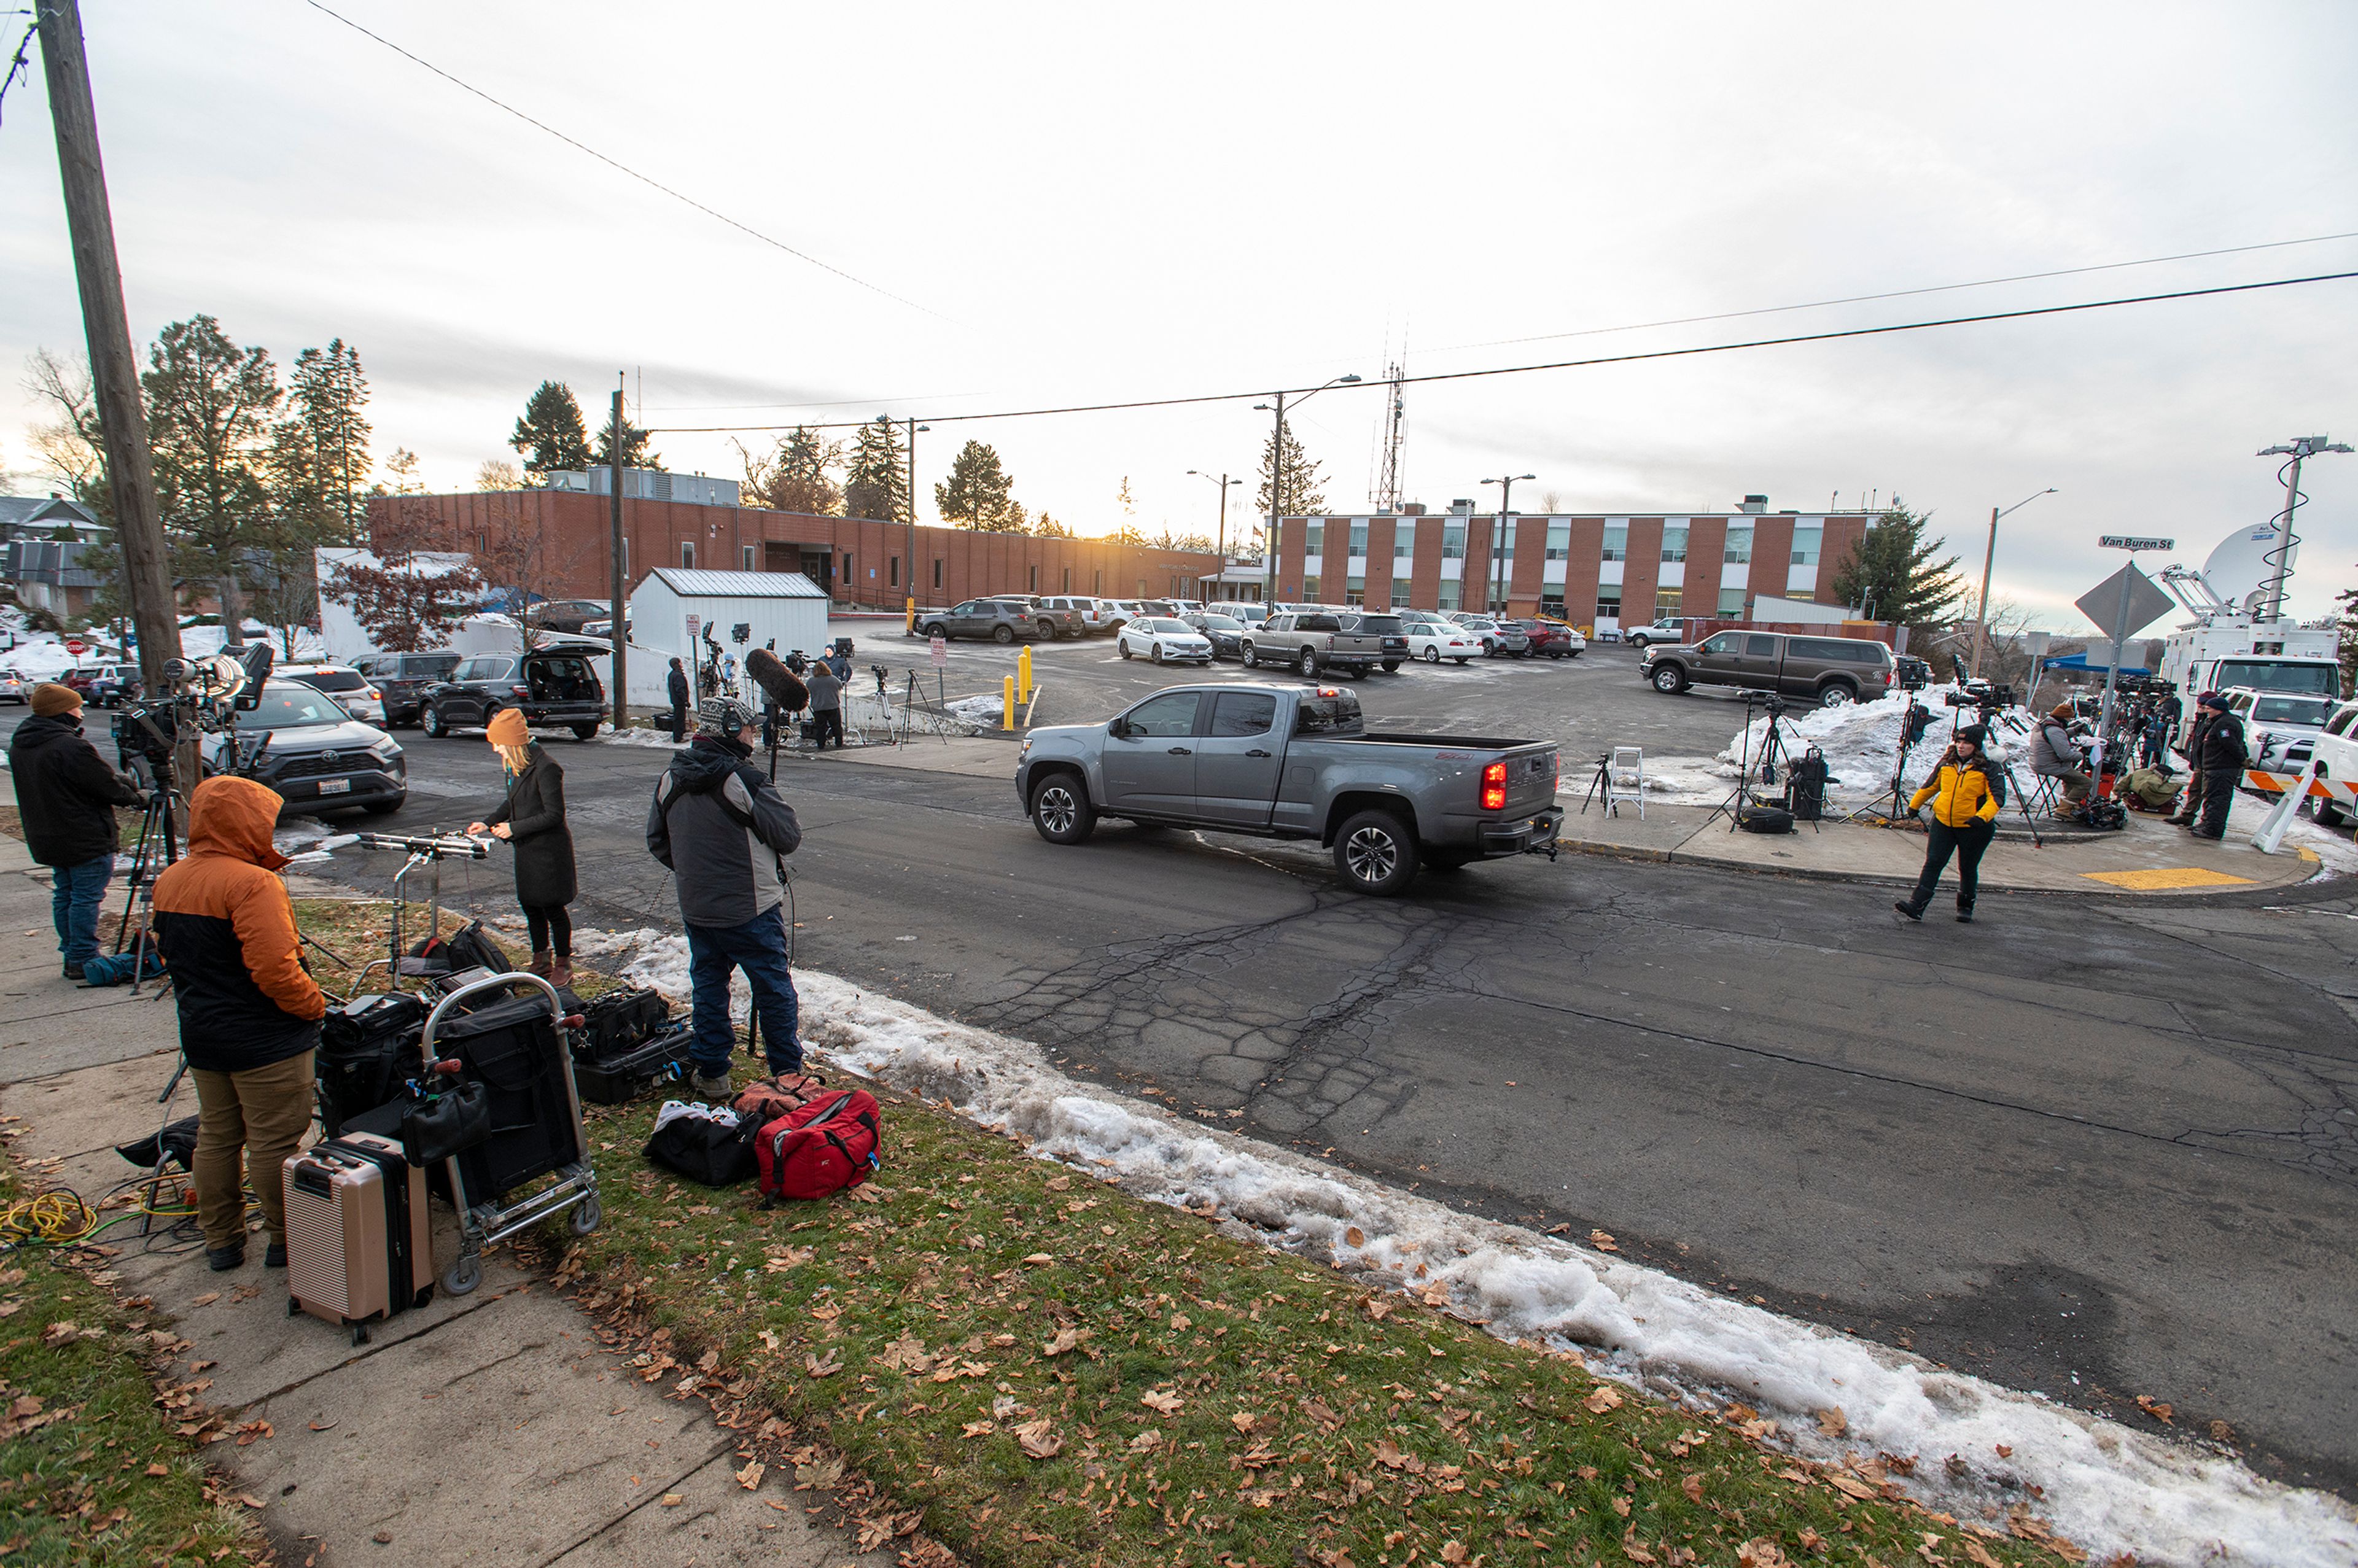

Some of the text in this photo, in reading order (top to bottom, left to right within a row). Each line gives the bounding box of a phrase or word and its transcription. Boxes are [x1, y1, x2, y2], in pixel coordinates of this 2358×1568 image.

[2103, 537, 2172, 549] Van Buren St
